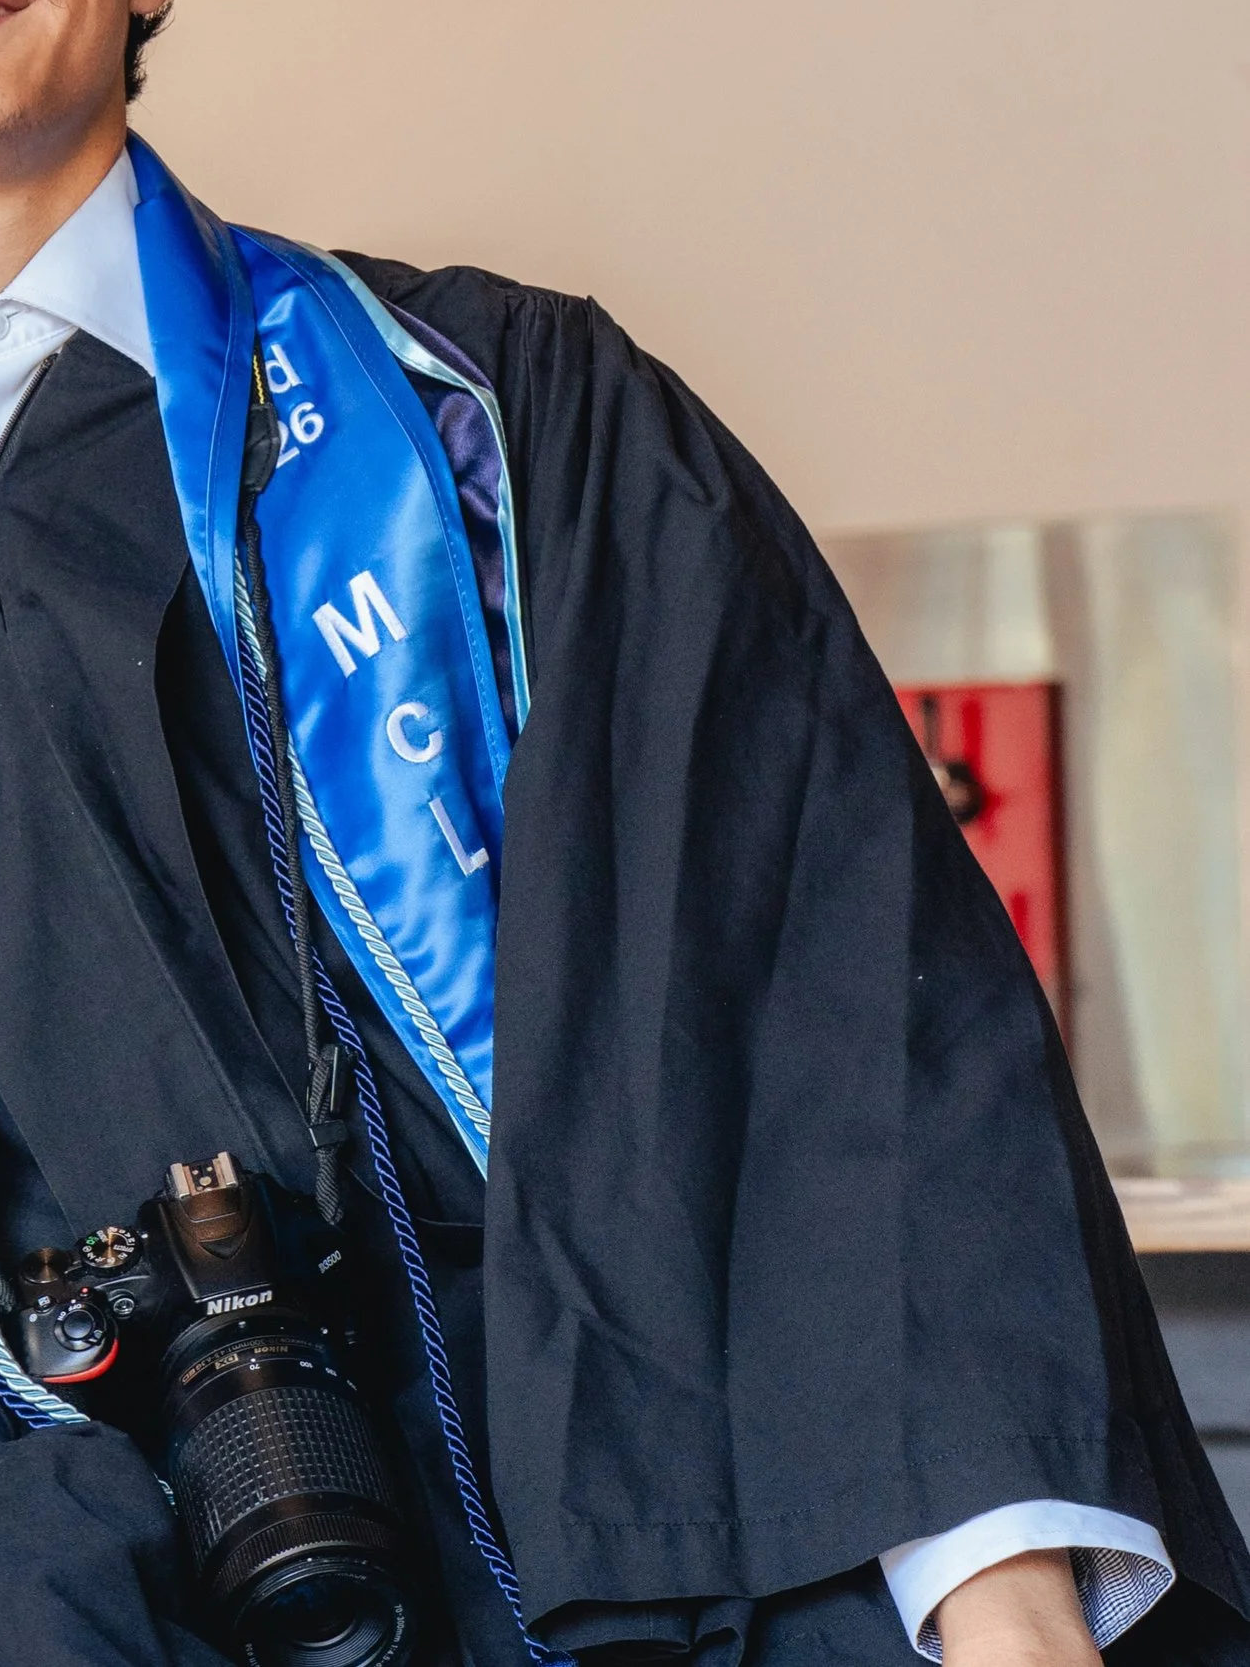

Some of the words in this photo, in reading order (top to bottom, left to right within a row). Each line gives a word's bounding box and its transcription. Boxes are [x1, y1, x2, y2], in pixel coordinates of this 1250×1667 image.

[206, 1289, 274, 1316] Nikon
[253, 1345, 289, 1354] Nikon
[299, 1361, 314, 1369] 100
[393, 1603, 405, 1643] 70-300mm
